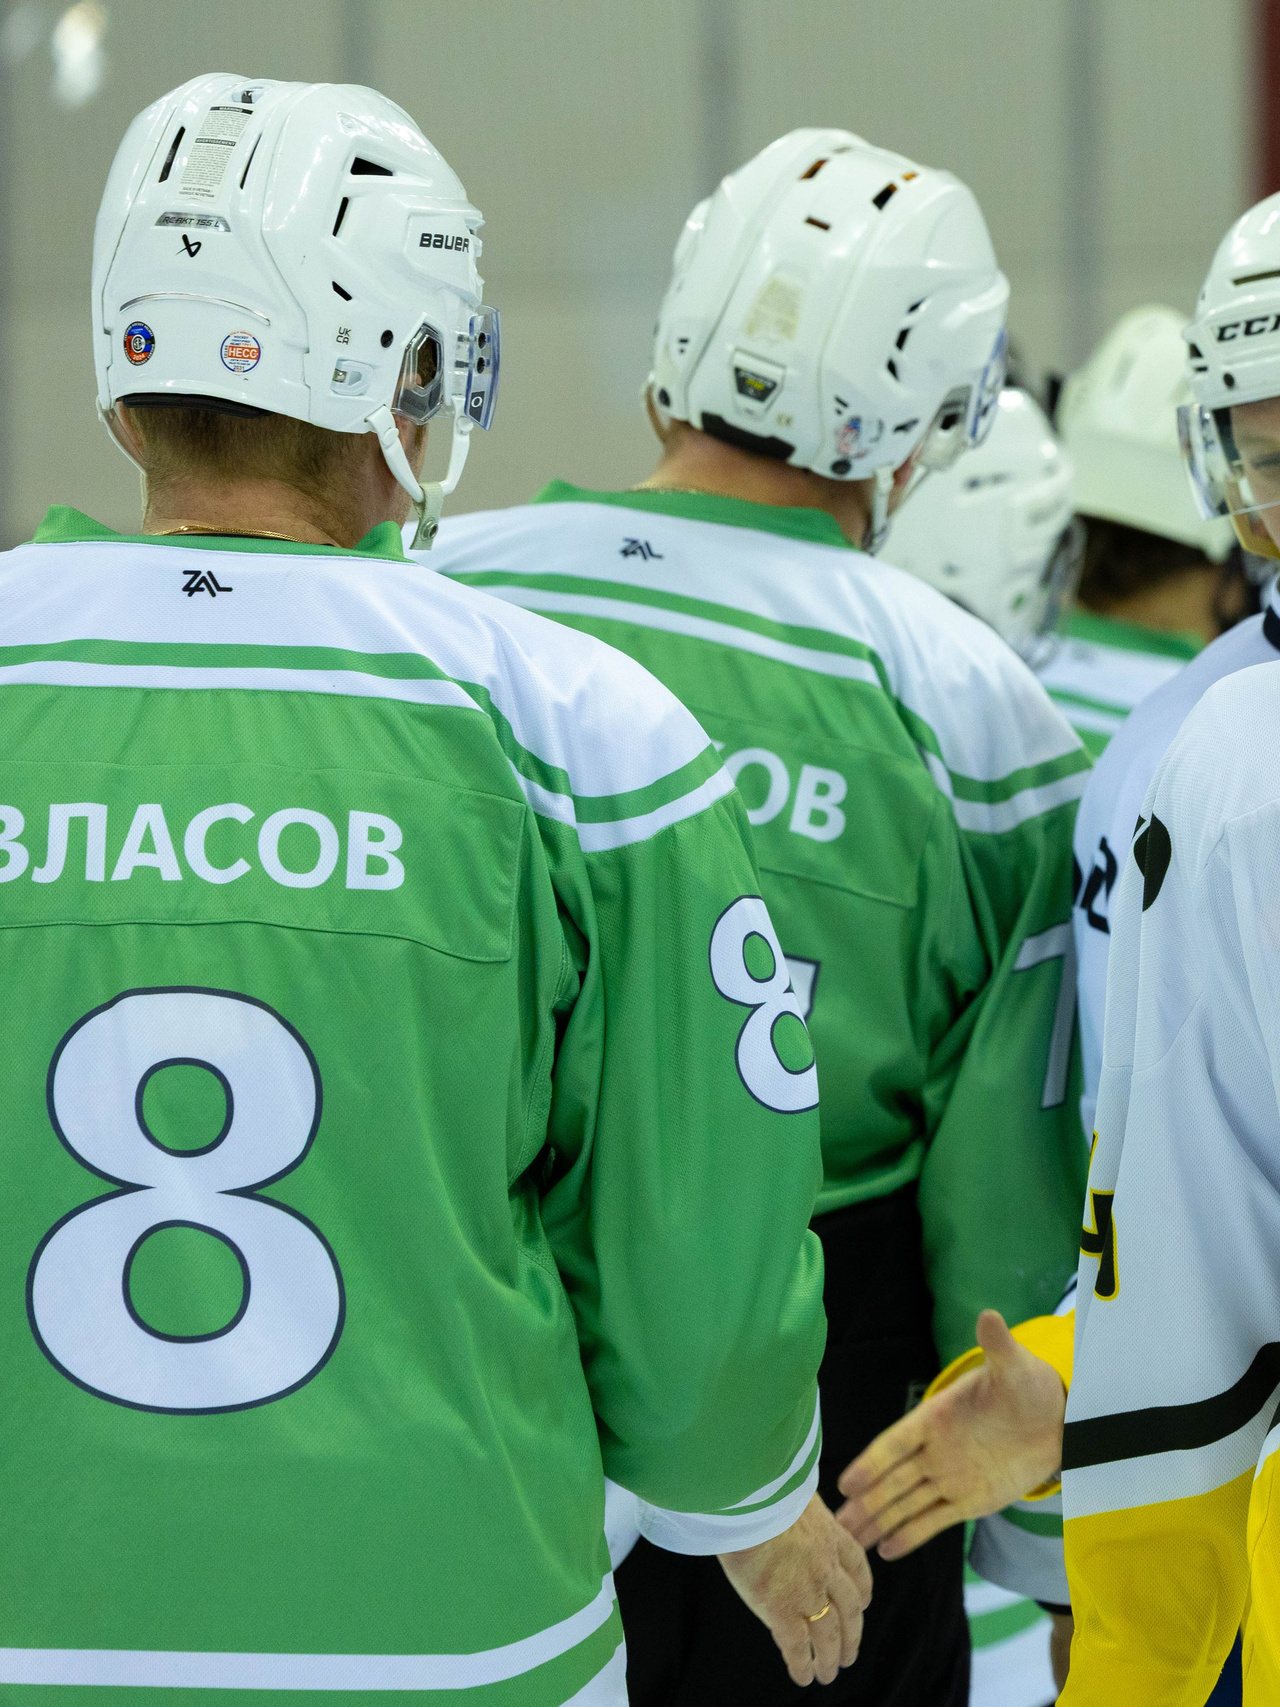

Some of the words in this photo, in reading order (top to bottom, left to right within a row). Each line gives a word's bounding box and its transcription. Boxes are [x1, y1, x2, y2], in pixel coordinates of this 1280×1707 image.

[338, 326, 351, 336] UK
[711, 738, 848, 842] ОВ
[708, 895, 820, 1115] 8
[25, 985, 347, 1416] 8
